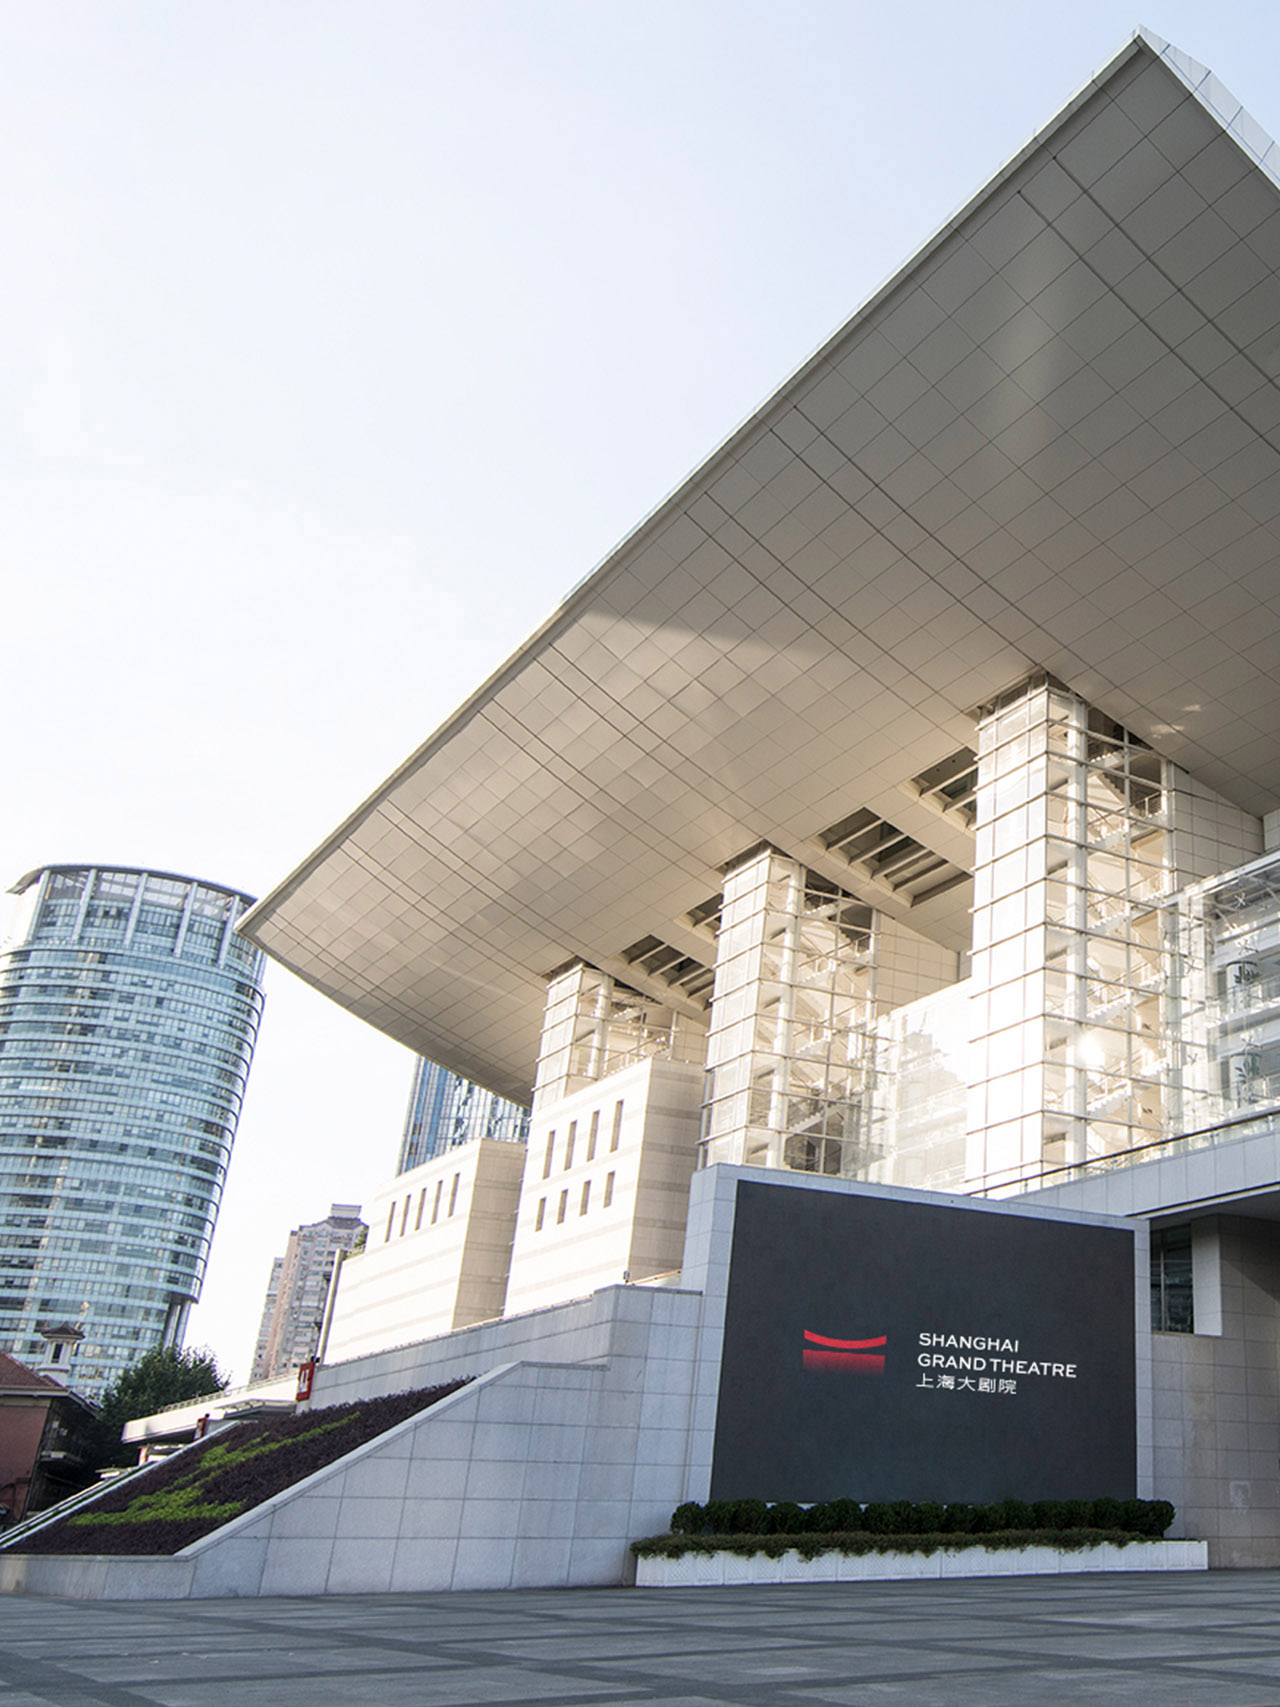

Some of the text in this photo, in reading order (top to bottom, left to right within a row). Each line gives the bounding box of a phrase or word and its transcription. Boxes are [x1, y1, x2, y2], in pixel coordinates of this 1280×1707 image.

[918, 1332, 1019, 1352] SHANGHAI
[917, 1353, 1077, 1378] GRAND THEATRE
[916, 1373, 1017, 1394] 上海大剧院
